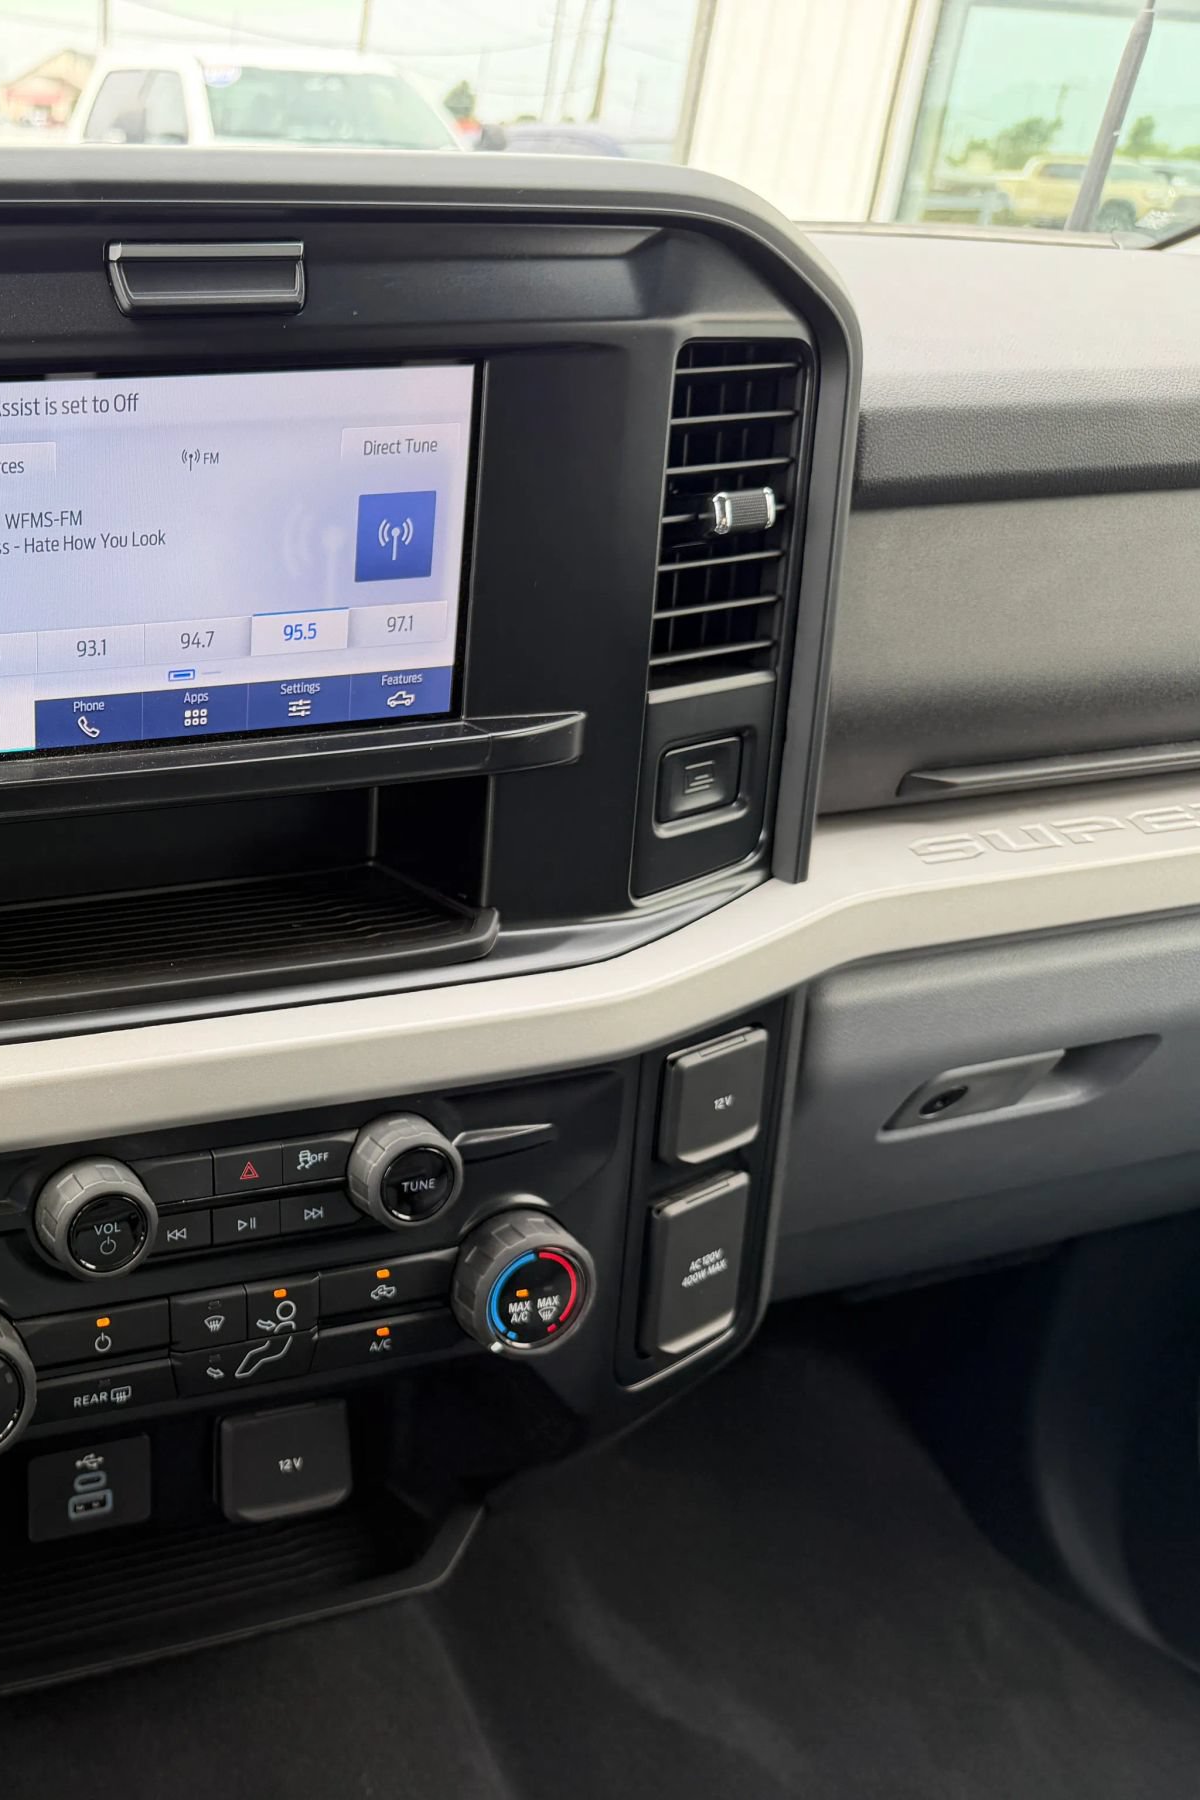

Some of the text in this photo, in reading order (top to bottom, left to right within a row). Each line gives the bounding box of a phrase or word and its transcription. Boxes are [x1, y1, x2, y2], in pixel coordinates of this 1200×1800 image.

[44, 396, 57, 416] is
[61, 395, 88, 415] set
[91, 395, 110, 414] to
[113, 392, 140, 413] Off
[362, 438, 438, 456] Direct Tune
[203, 451, 220, 465] FM
[4, 509, 83, 530] WFMS-FM
[24, 537, 60, 554] Hate
[63, 534, 96, 551] How
[99, 532, 128, 549] You
[132, 529, 166, 548] Look
[282, 622, 318, 641] 95.5
[386, 615, 414, 633] 97.1
[179, 630, 215, 650] 94.7
[76, 638, 107, 658] 93.1
[381, 673, 423, 687] Features
[280, 680, 321, 696] Settings
[183, 691, 209, 705] Apps
[73, 700, 105, 713] Phone
[908, 804, 1200, 865] SUPE
[713, 1094, 734, 1111] 12V
[310, 1152, 329, 1163] OFF
[401, 1178, 436, 1193] TUNE
[93, 1221, 121, 1236] VOL
[508, 1300, 530, 1314] MAX
[537, 1294, 560, 1309] MAX
[510, 1311, 529, 1325] A/C
[369, 1338, 392, 1352] A/C
[73, 1391, 108, 1408] REAR
[278, 1457, 303, 1471] 12V
